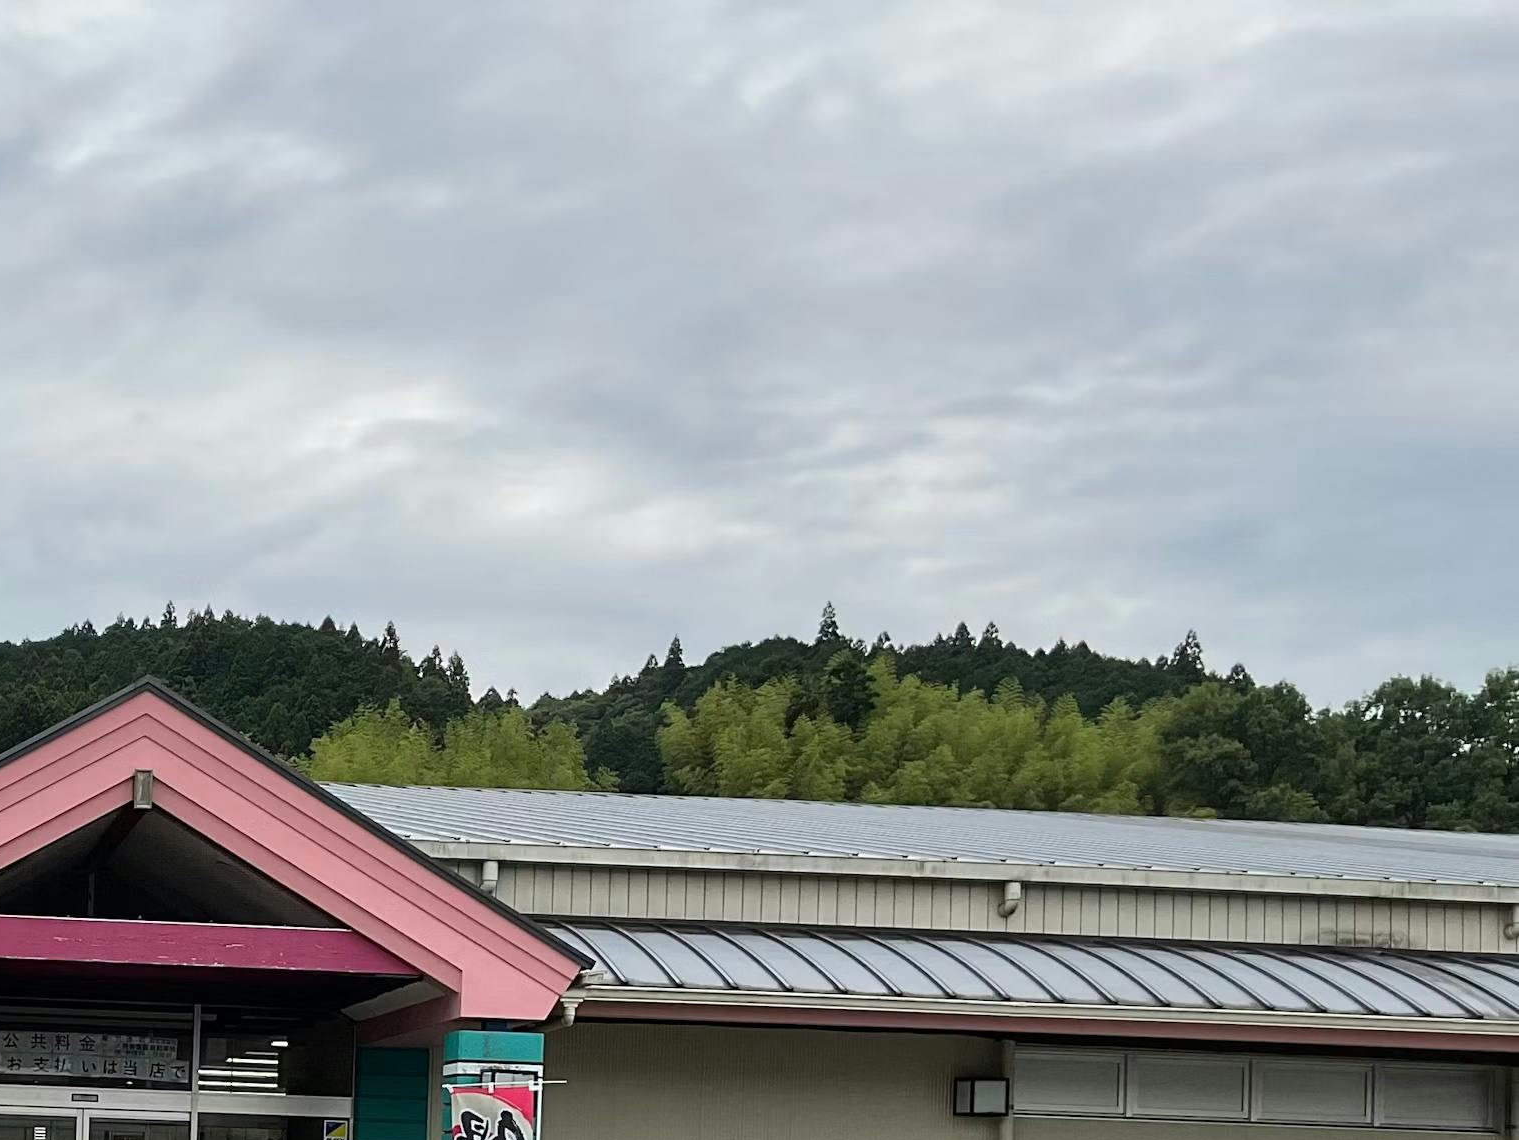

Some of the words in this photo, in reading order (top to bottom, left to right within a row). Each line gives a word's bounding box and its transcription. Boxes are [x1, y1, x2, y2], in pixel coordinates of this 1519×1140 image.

[2, 1032, 96, 1053] 公共料金
[6, 1055, 187, 1079] お支払いは当店で
